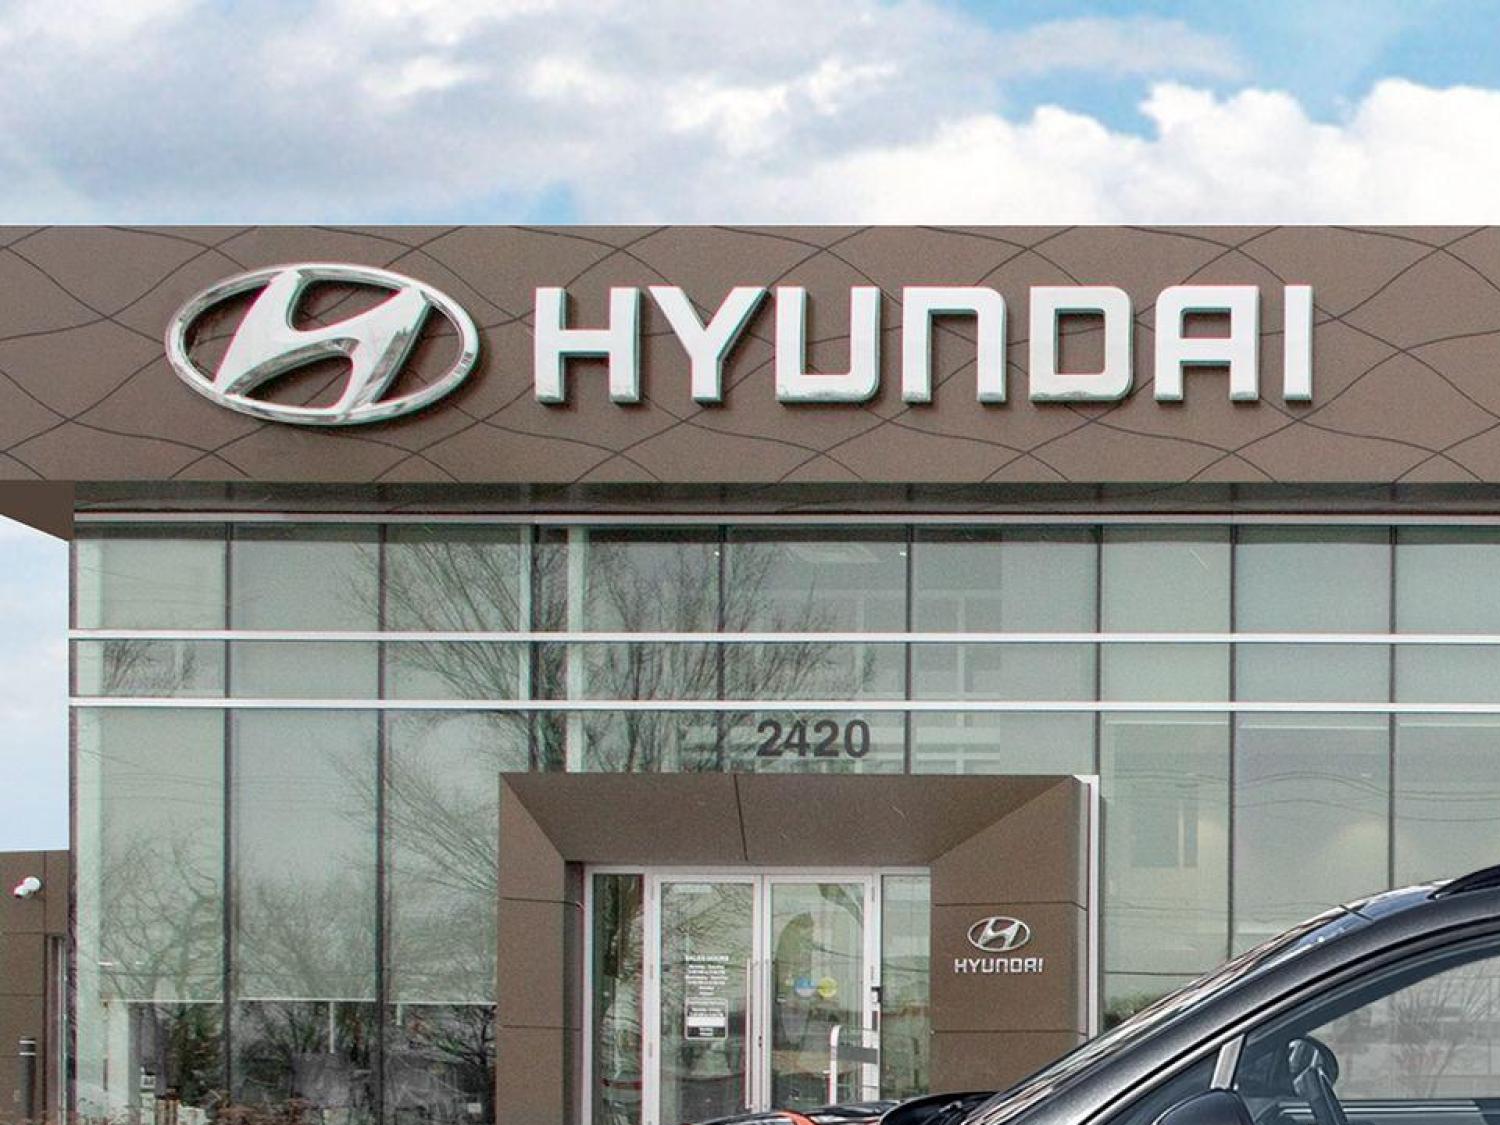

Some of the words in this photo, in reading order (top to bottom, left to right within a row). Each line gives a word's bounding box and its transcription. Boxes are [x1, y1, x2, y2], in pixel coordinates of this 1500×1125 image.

[534, 284, 1314, 403] HYUNDAI
[756, 718, 871, 759] 2420
[954, 957, 1044, 974] HYUNDAI
